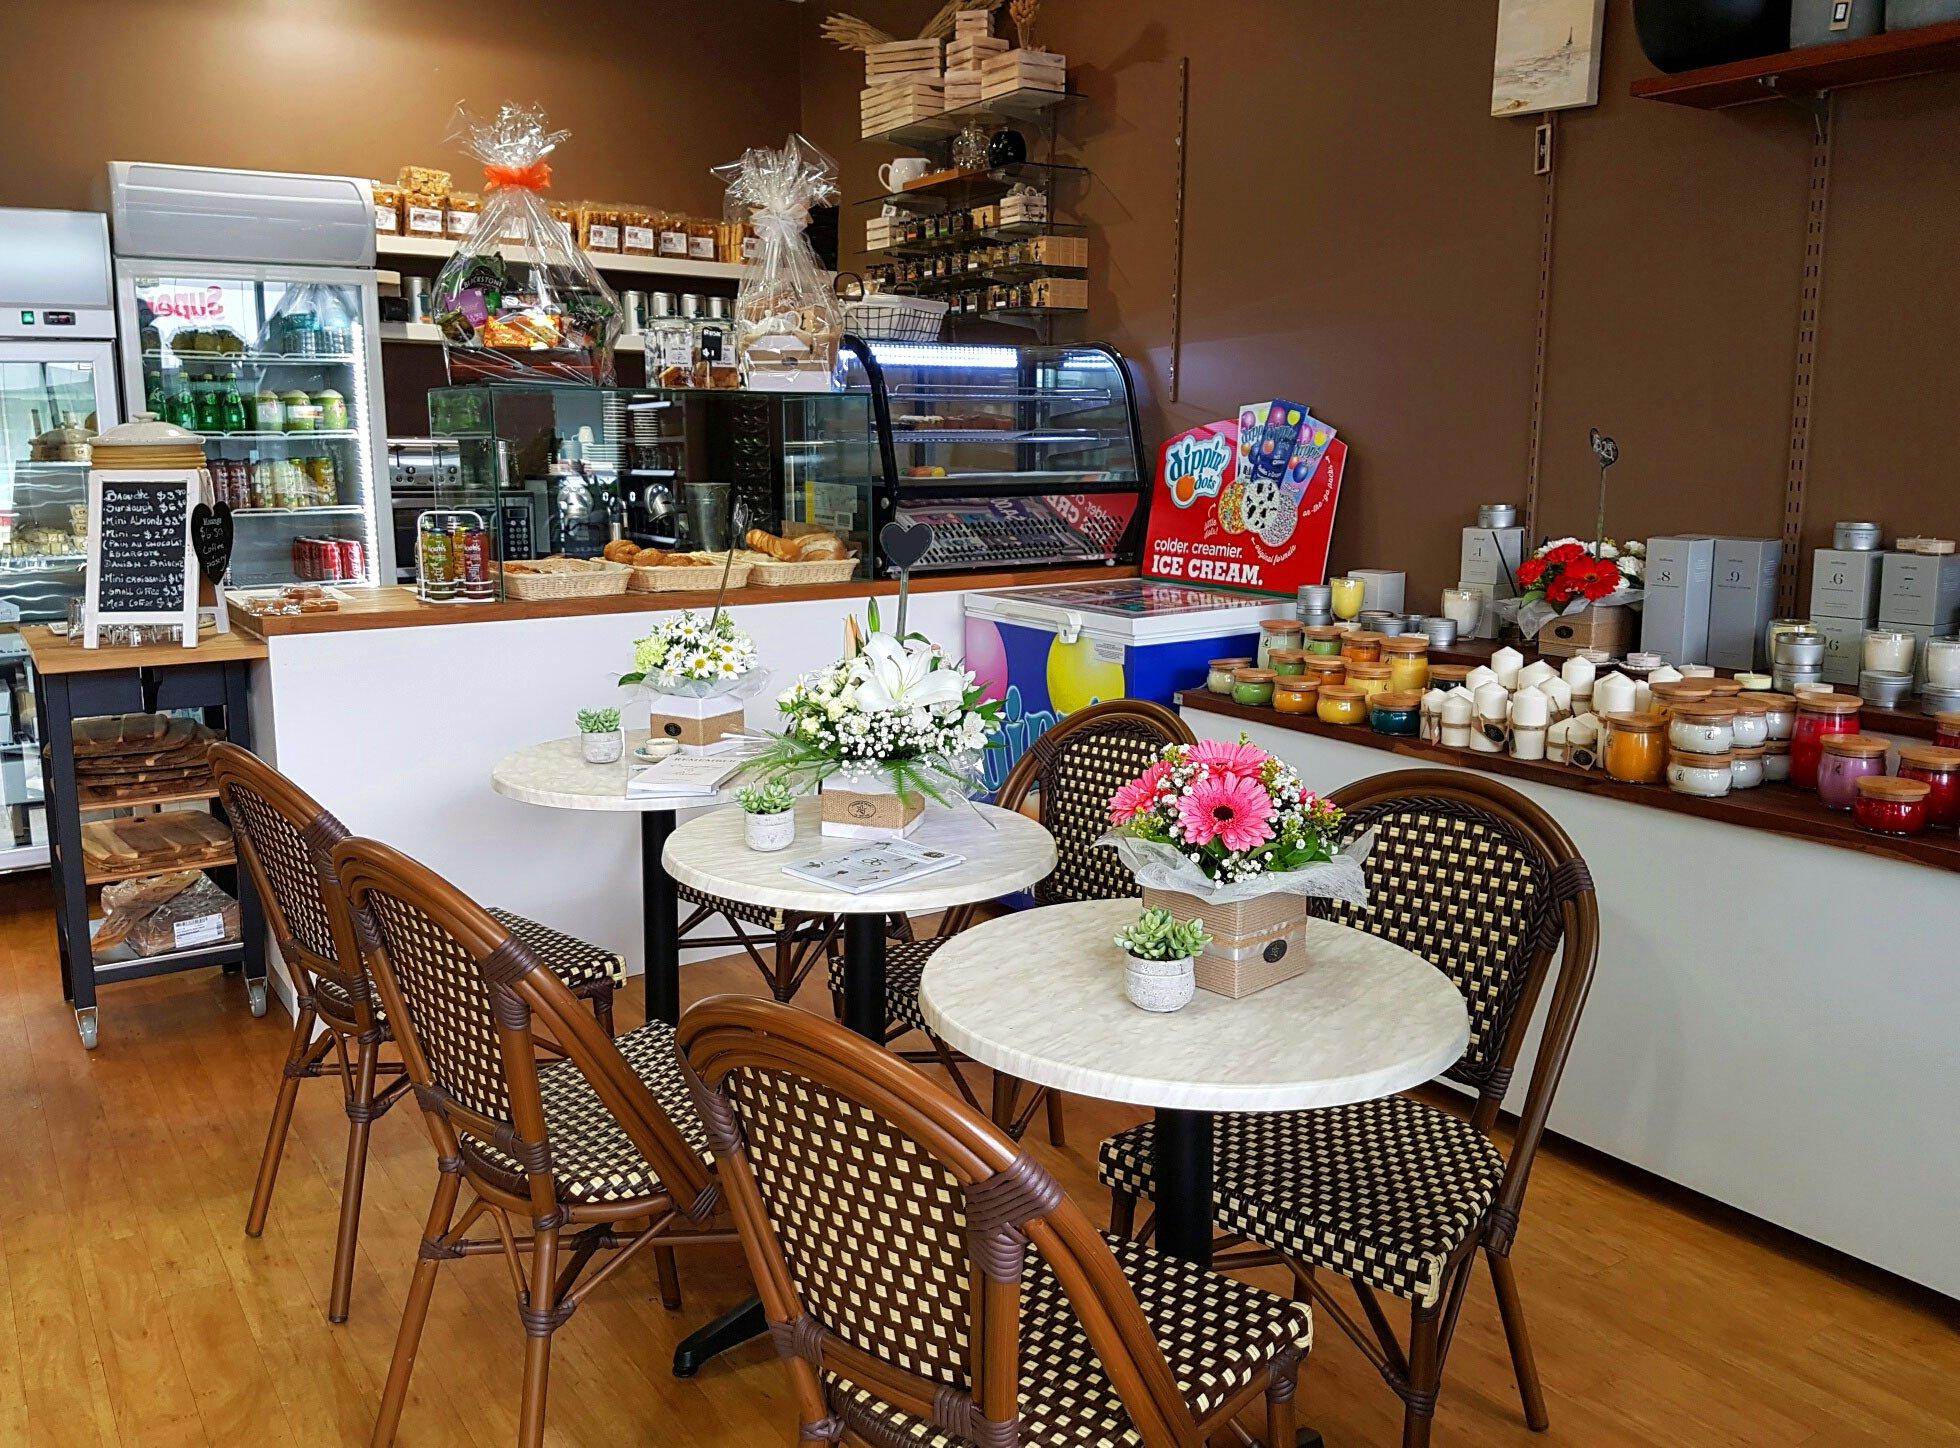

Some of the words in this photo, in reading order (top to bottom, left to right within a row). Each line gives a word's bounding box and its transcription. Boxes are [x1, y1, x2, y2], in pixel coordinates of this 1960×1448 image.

[463, 276, 503, 288] BLACKSTONE
[1167, 440, 1223, 481] dippin'
[1194, 474, 1216, 490] dots
[1154, 538, 1190, 554] colder.
[1192, 542, 1242, 558] creamier.
[1152, 555, 1183, 575] ICE
[1188, 559, 1264, 585] CREAM.
